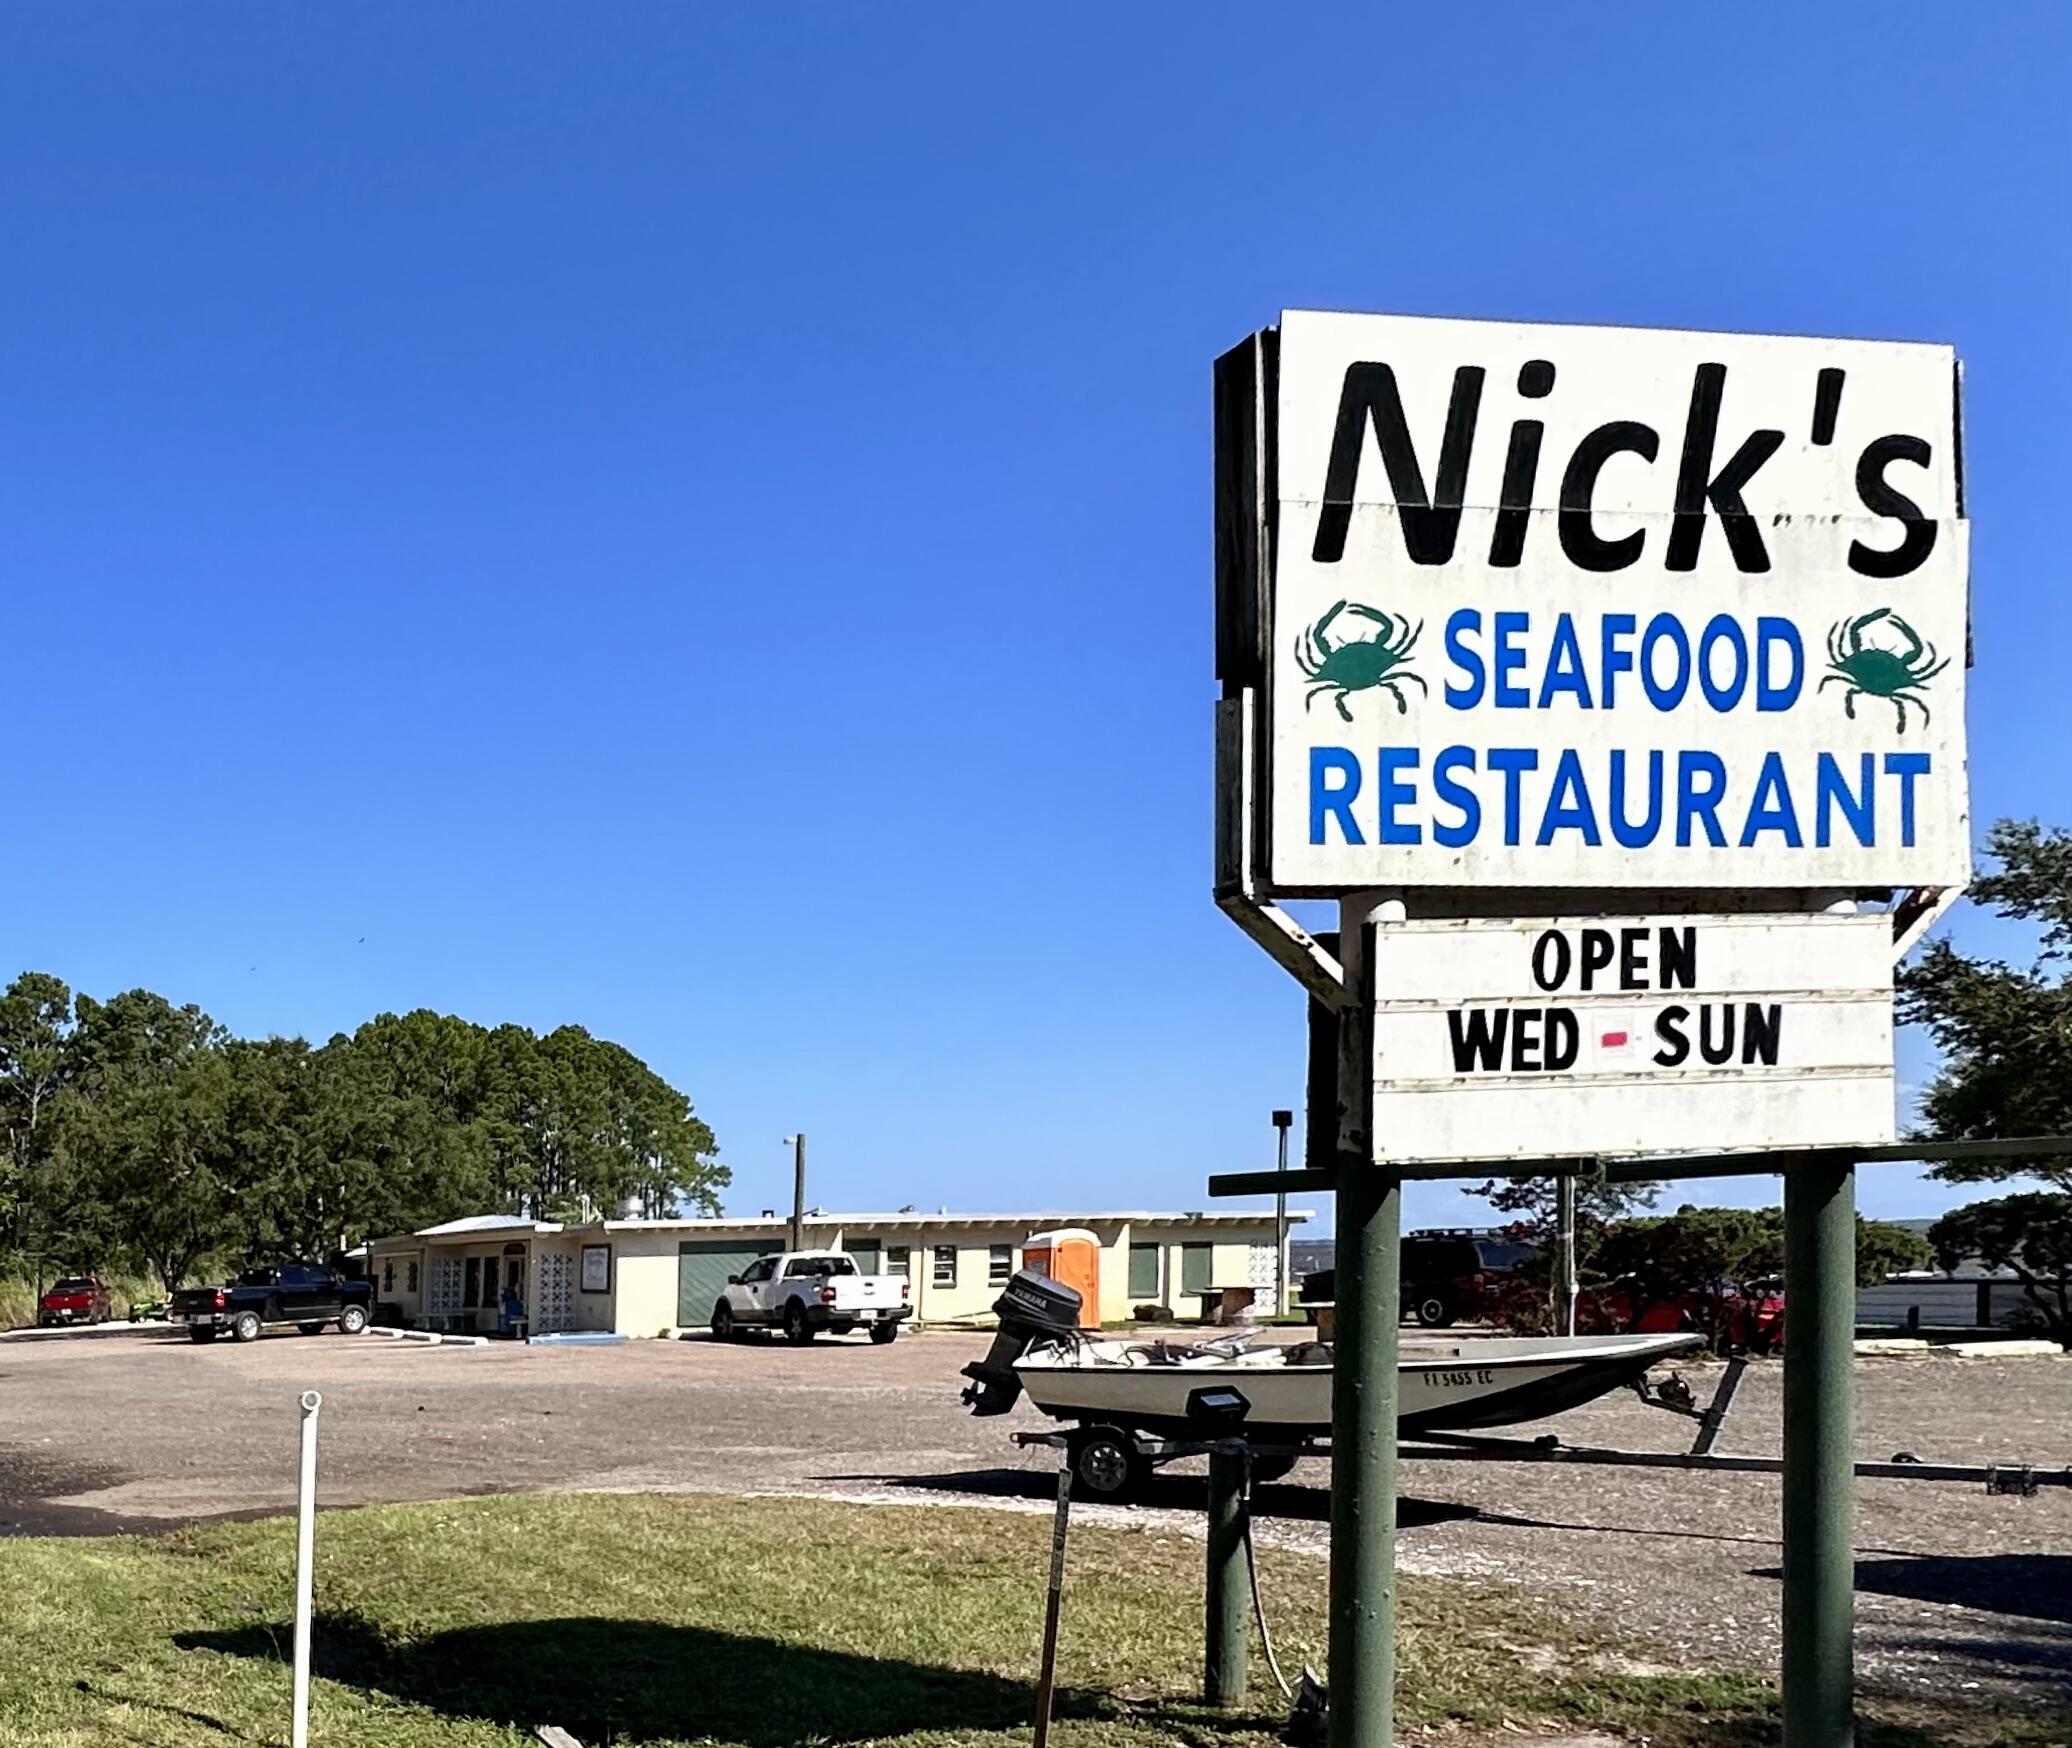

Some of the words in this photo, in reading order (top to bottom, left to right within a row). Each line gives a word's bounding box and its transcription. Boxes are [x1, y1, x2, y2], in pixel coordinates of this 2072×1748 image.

[1311, 359, 1938, 579] Nick's
[1444, 608, 1805, 713] SEAFOOD
[1309, 745, 1931, 849] RESTAURANT
[1532, 926, 1697, 992] OPEN
[1447, 1007, 1580, 1073] WED
[1652, 1002, 1782, 1067] SUN
